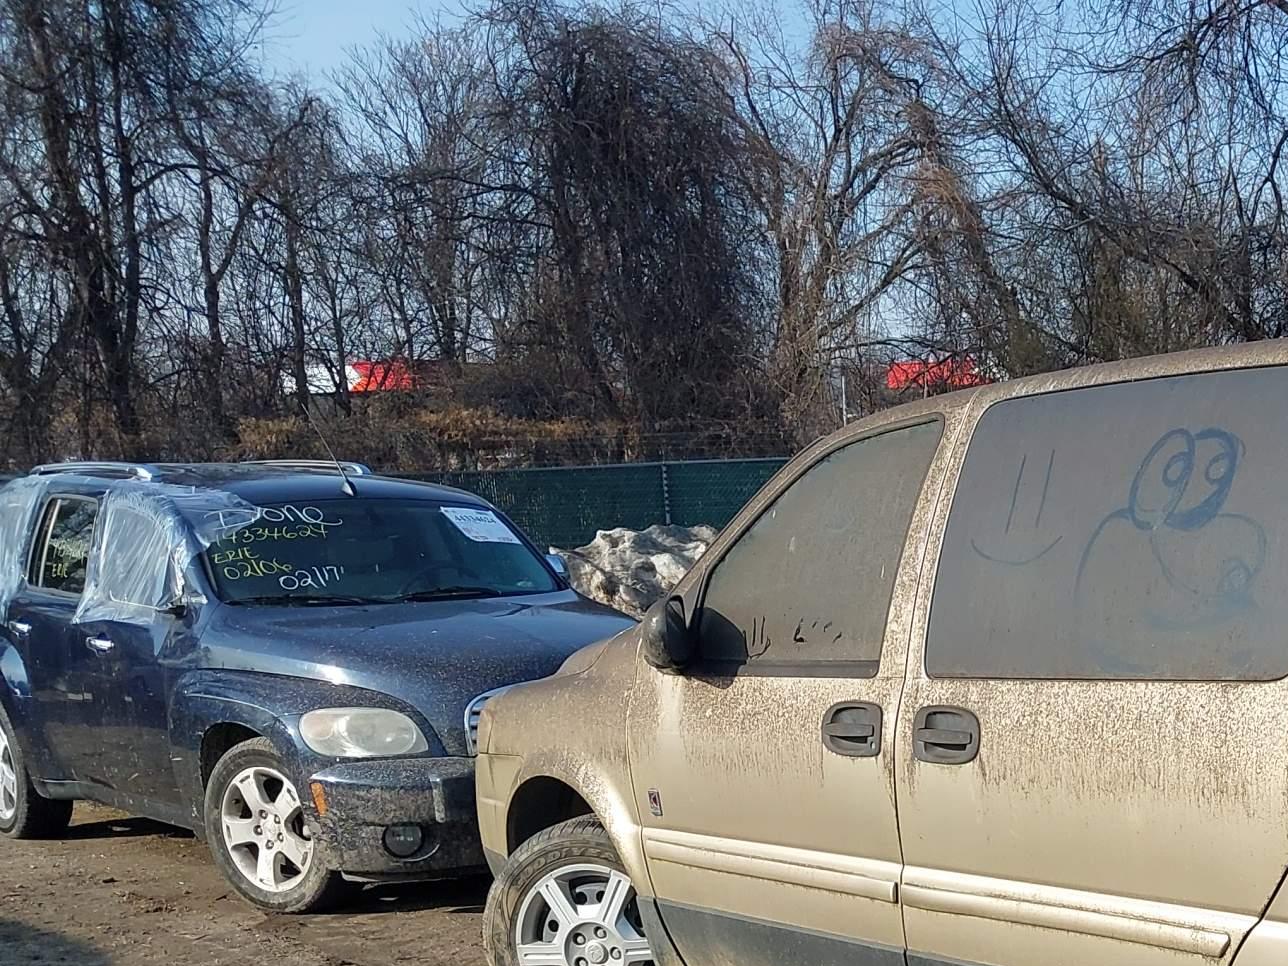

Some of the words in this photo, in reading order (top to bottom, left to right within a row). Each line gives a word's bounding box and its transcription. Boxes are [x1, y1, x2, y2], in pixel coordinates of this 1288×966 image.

[204, 504, 343, 530] Done
[212, 547, 260, 564] ERIE
[223, 557, 293, 580] 02/06
